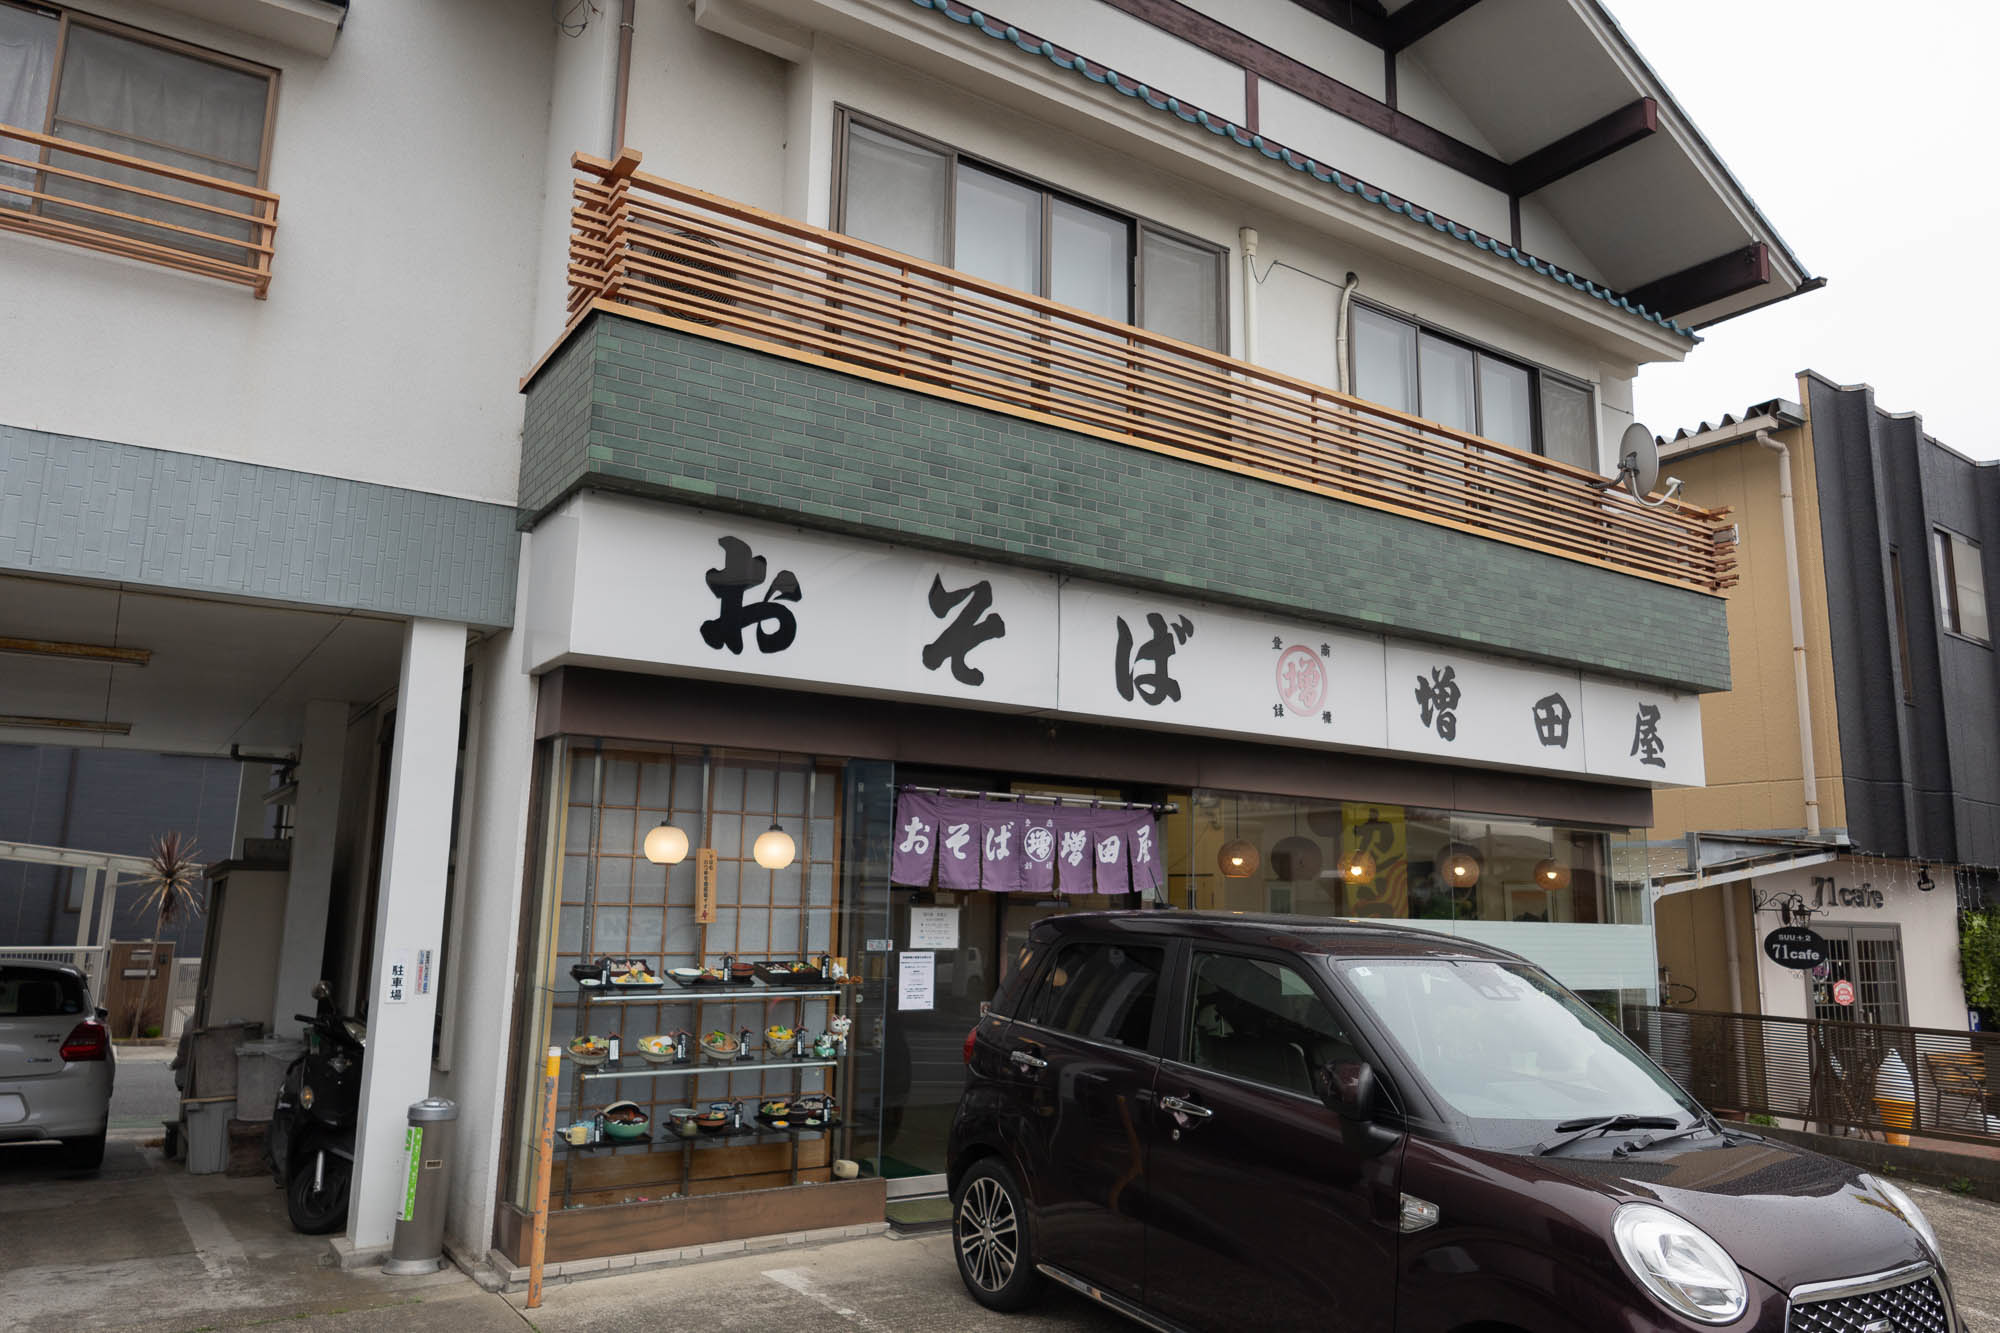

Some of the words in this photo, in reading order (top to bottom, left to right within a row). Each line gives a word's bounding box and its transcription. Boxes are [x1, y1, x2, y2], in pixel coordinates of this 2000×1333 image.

[700, 536, 1194, 706] おそば
[1415, 665, 1666, 768] 増田屋
[900, 817, 1014, 861] おそば
[1772, 944, 1820, 960] 71cafe
[390, 965, 404, 1000] 駐車場
[1970, 1011, 1979, 1030] P
